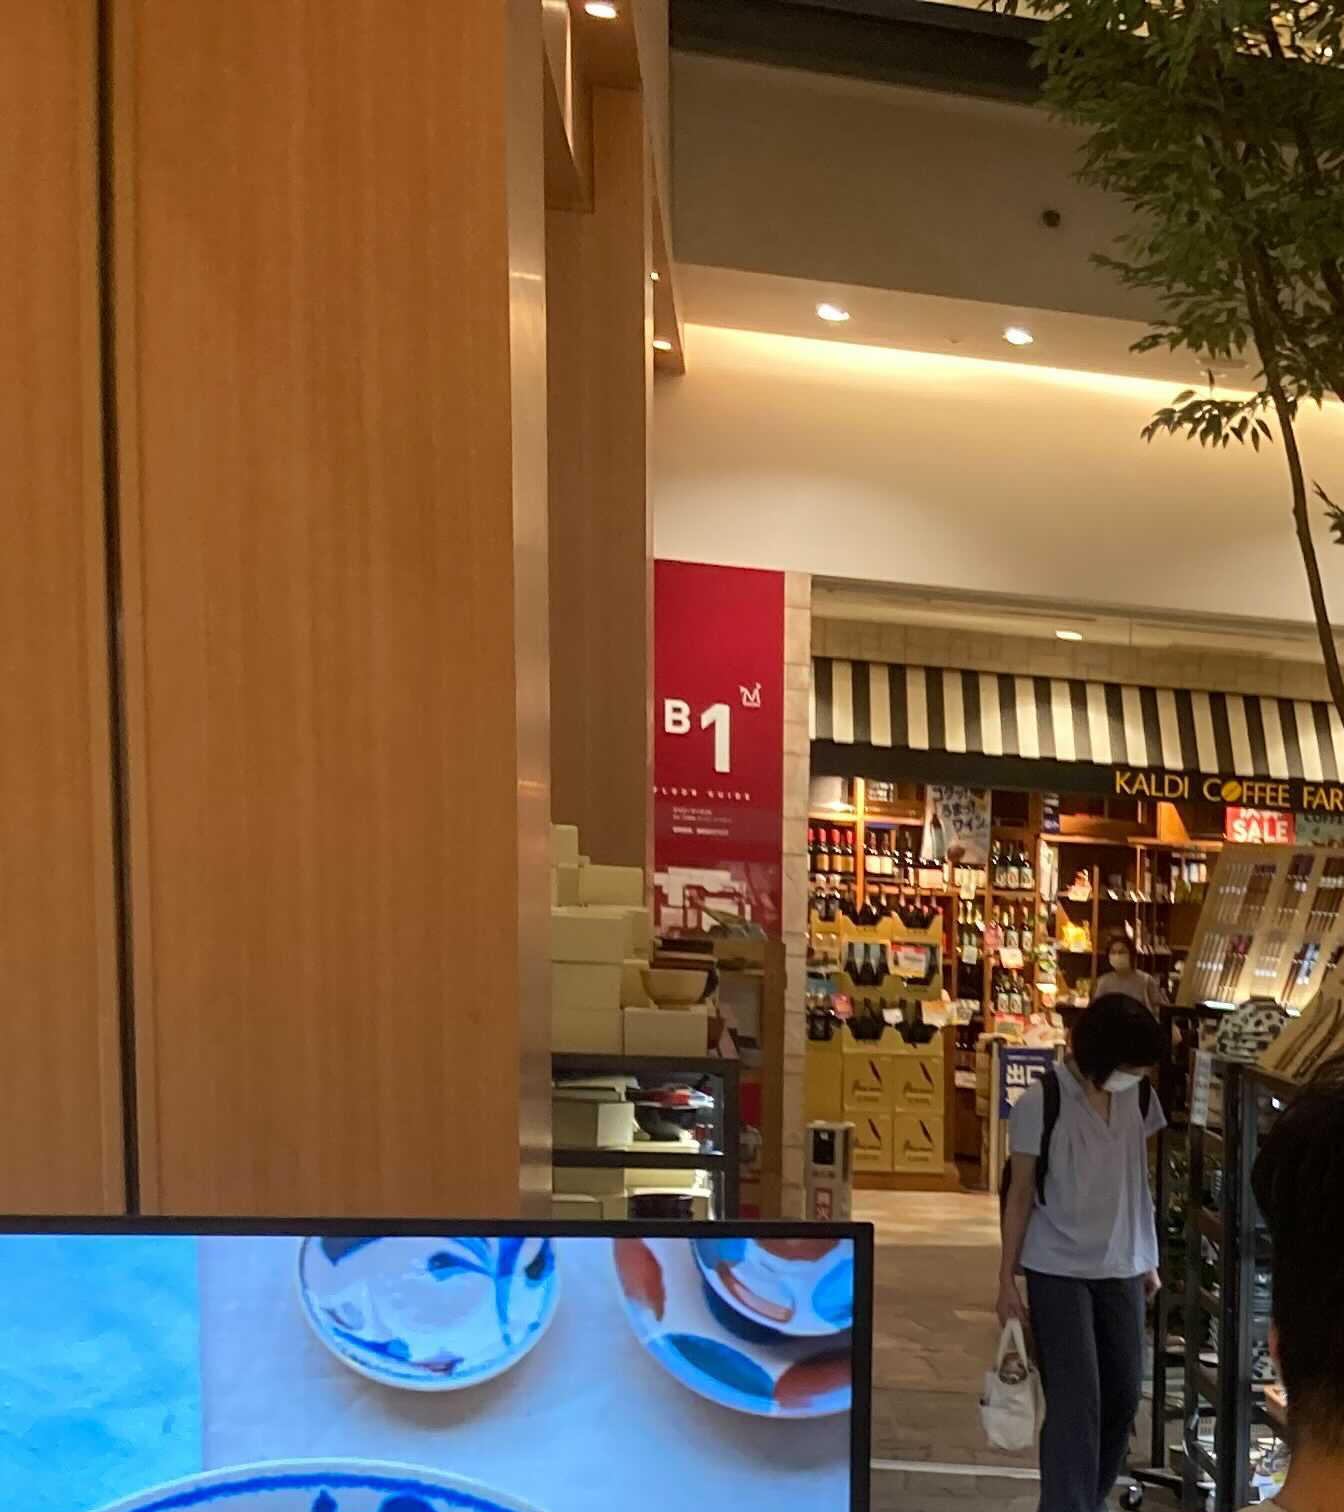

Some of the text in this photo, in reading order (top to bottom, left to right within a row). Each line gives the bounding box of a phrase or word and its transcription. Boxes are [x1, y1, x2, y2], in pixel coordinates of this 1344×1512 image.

[1114, 770, 1189, 800] KALDI
[1202, 777, 1291, 808] COFFEE
[1231, 818, 1289, 844] SALE
